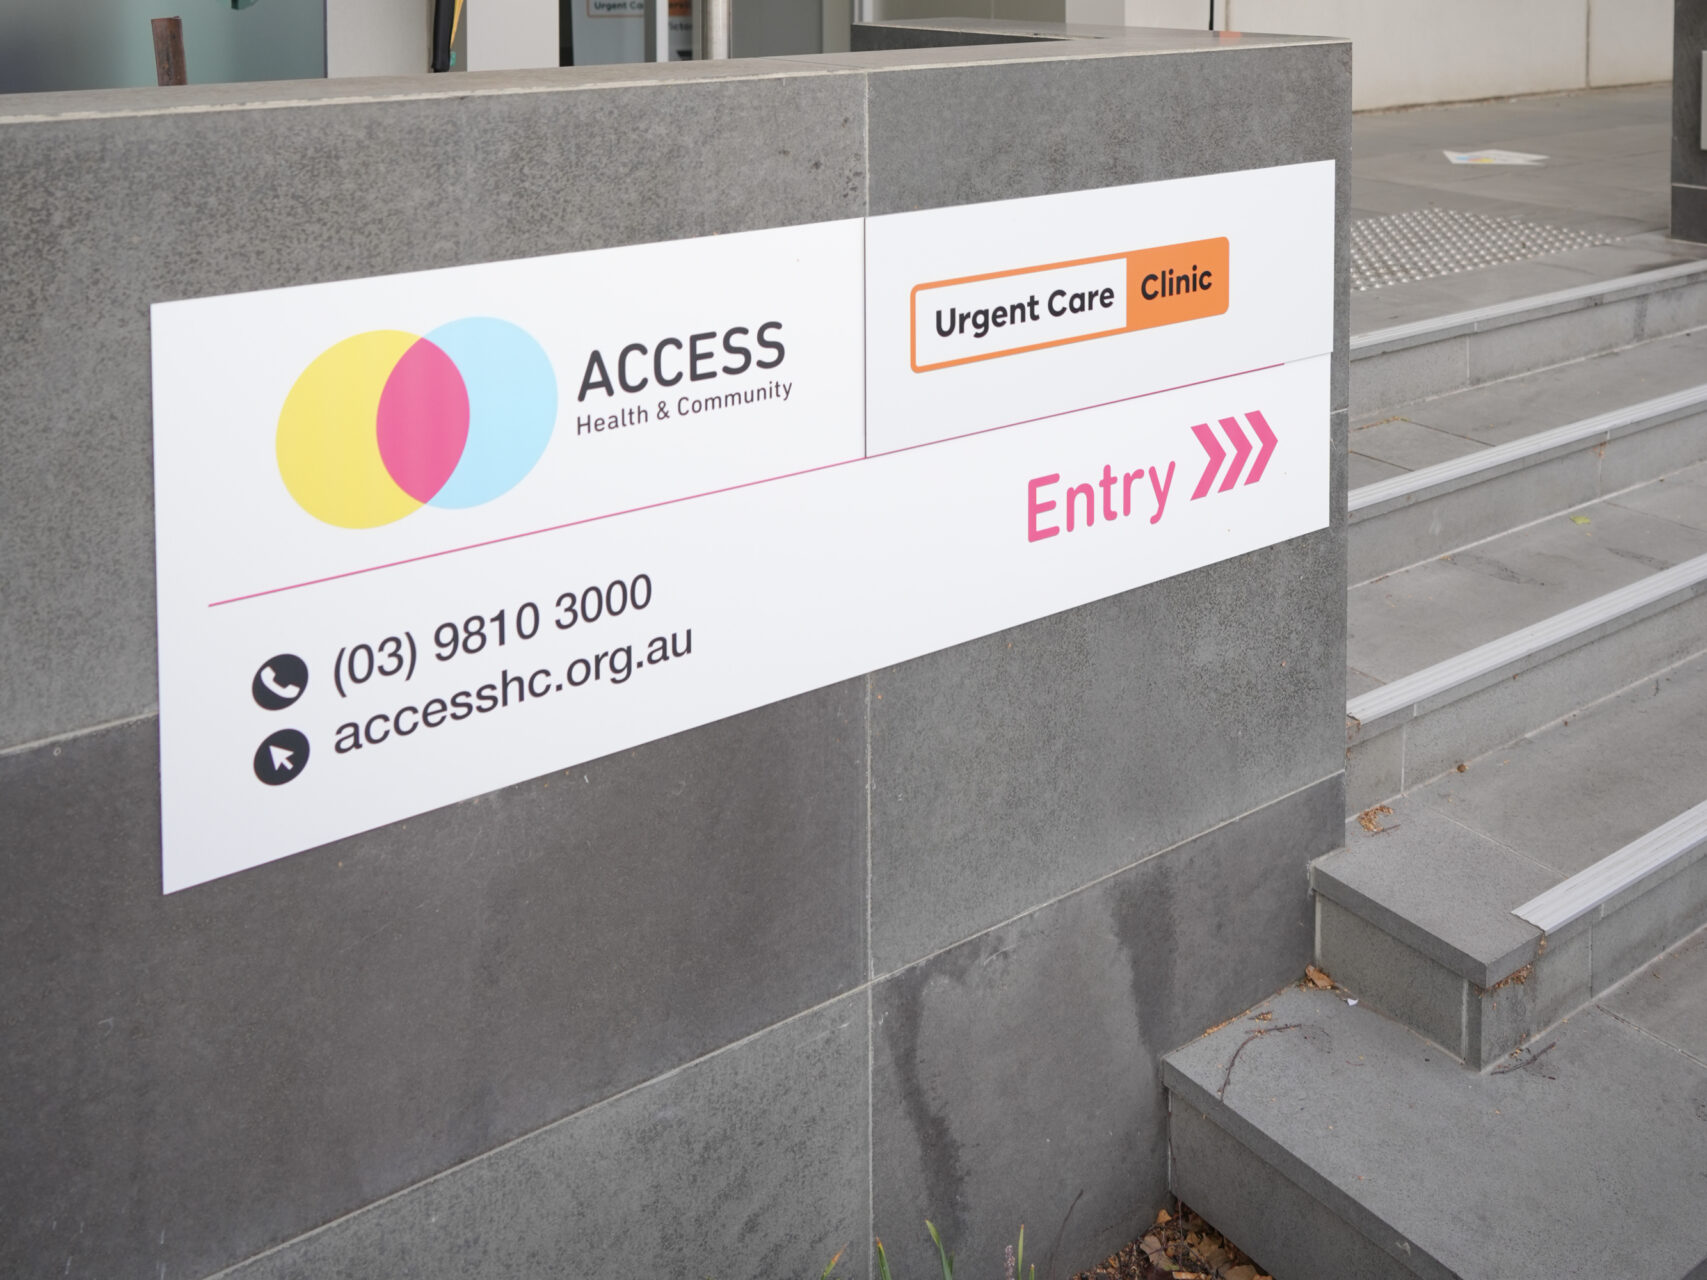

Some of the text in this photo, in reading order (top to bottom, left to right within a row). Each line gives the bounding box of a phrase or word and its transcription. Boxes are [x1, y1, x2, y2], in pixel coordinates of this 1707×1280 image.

[594, 1, 628, 12] Urgent
[936, 264, 1213, 338] Urgent Care Clinic
[578, 321, 786, 402] ACCESS
[577, 380, 793, 436] Health & Community
[1028, 464, 1176, 543] Entry
[333, 573, 652, 698] (03) 9810 3000
[334, 628, 693, 754] accesshc.org.au
